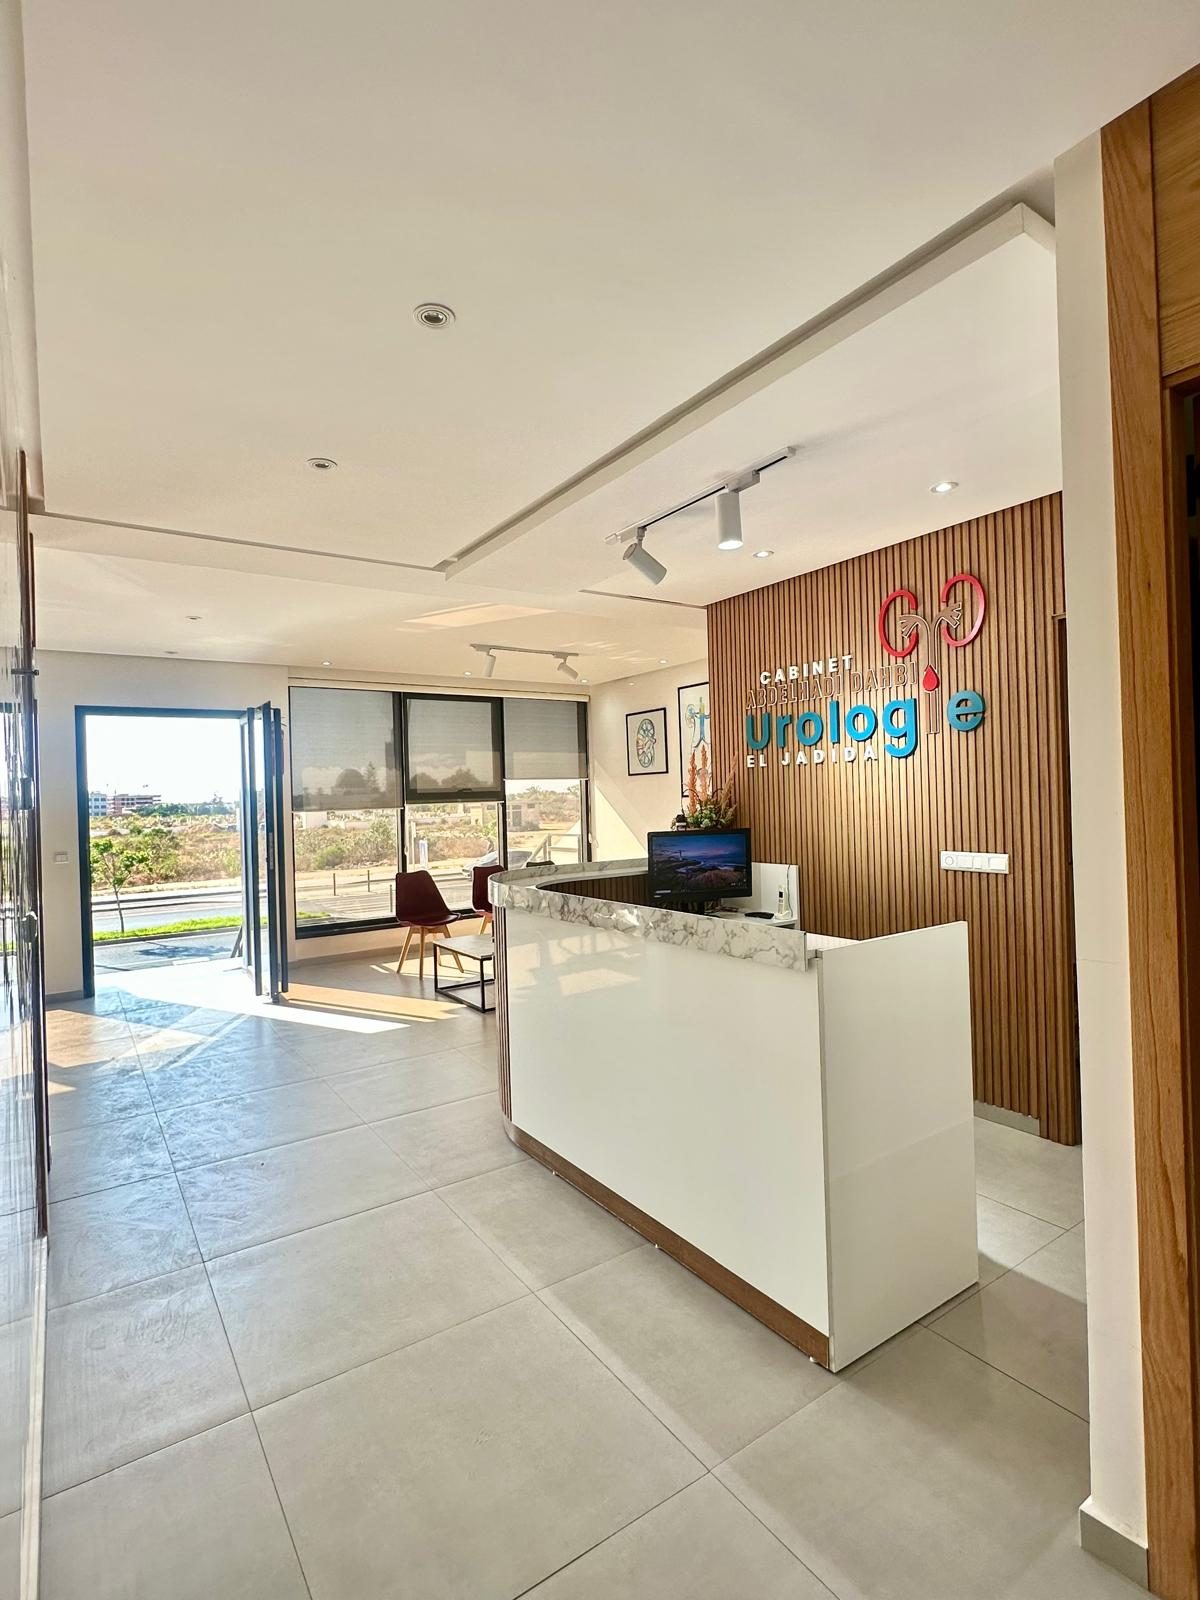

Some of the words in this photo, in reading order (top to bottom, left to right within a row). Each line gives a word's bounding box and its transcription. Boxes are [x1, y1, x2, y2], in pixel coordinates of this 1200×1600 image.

[746, 675, 842, 709] ABDELHADI
[850, 661, 917, 694] DAHBI
[760, 654, 852, 685] CABINET
[746, 754, 767, 768] EL
[781, 745, 878, 767] JADIDA
